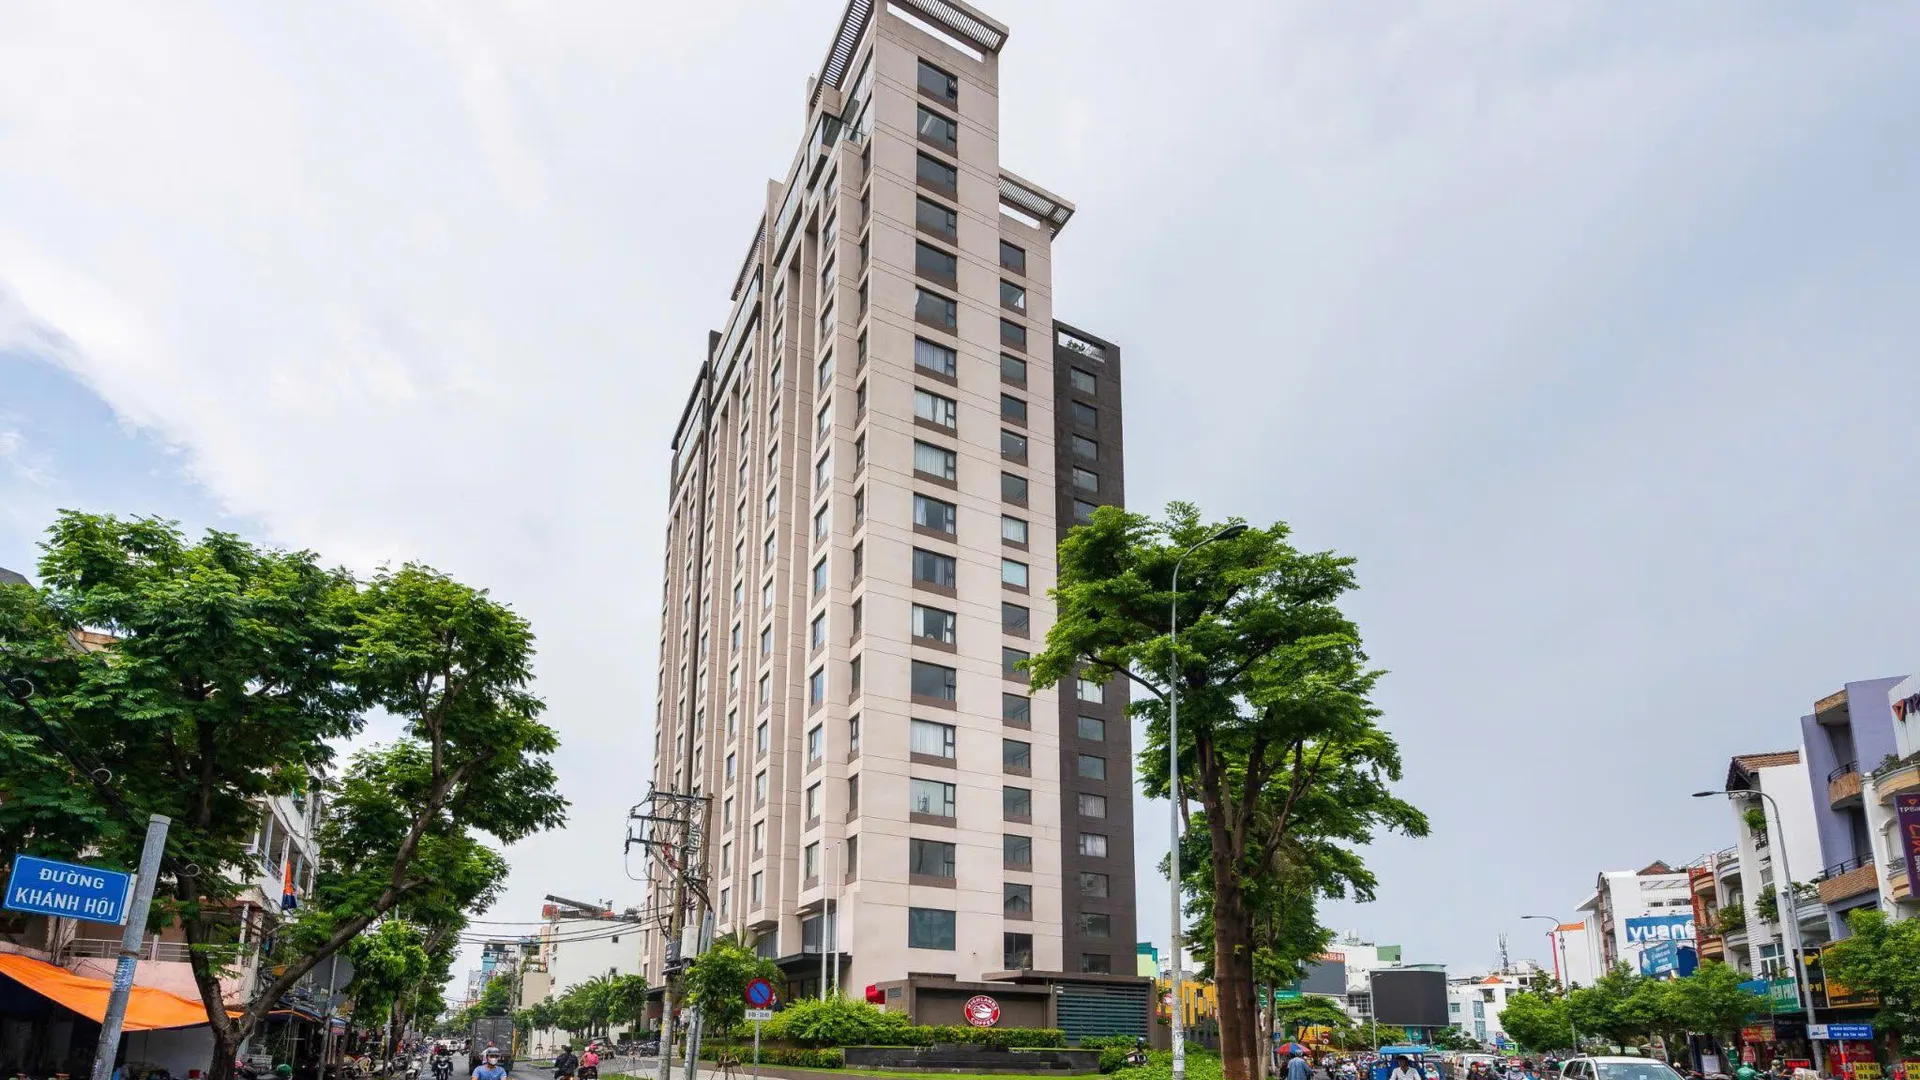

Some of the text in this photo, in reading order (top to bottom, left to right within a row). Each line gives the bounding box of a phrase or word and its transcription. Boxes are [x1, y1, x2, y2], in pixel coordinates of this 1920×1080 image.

[39, 868, 104, 889] ĐƯỜNG
[15, 887, 115, 917] KHÁNH HỘI
[968, 998, 997, 1010] HIGHLANDS
[971, 1017, 994, 1025] COFFEE
